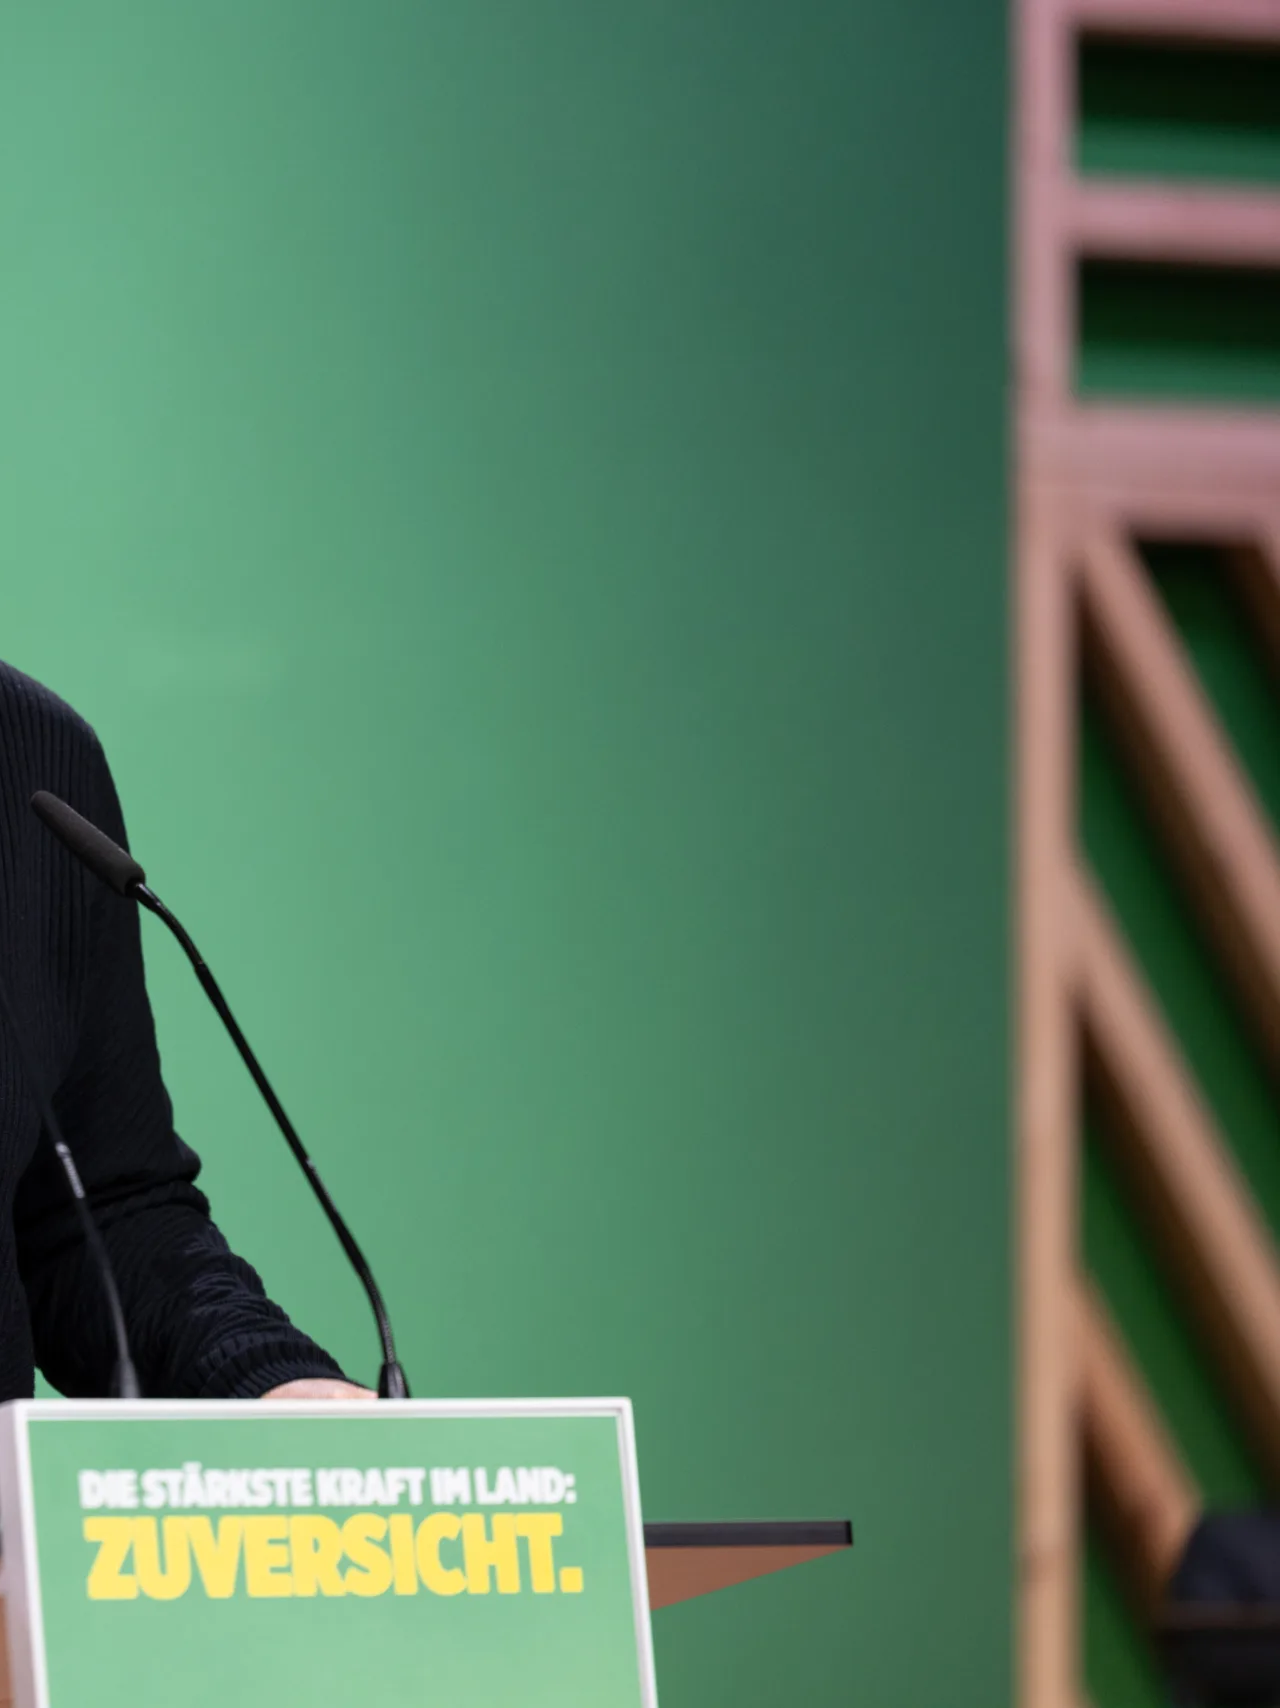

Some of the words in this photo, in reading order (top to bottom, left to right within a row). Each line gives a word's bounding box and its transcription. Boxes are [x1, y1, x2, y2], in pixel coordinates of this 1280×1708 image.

[79, 1470, 139, 1508] DIE
[143, 1462, 313, 1507] STÄRKSTE
[316, 1468, 425, 1506] KRAFT
[431, 1468, 471, 1505] IM
[477, 1467, 577, 1504] LAND:
[84, 1513, 584, 1600] ZUVERSICHT.
